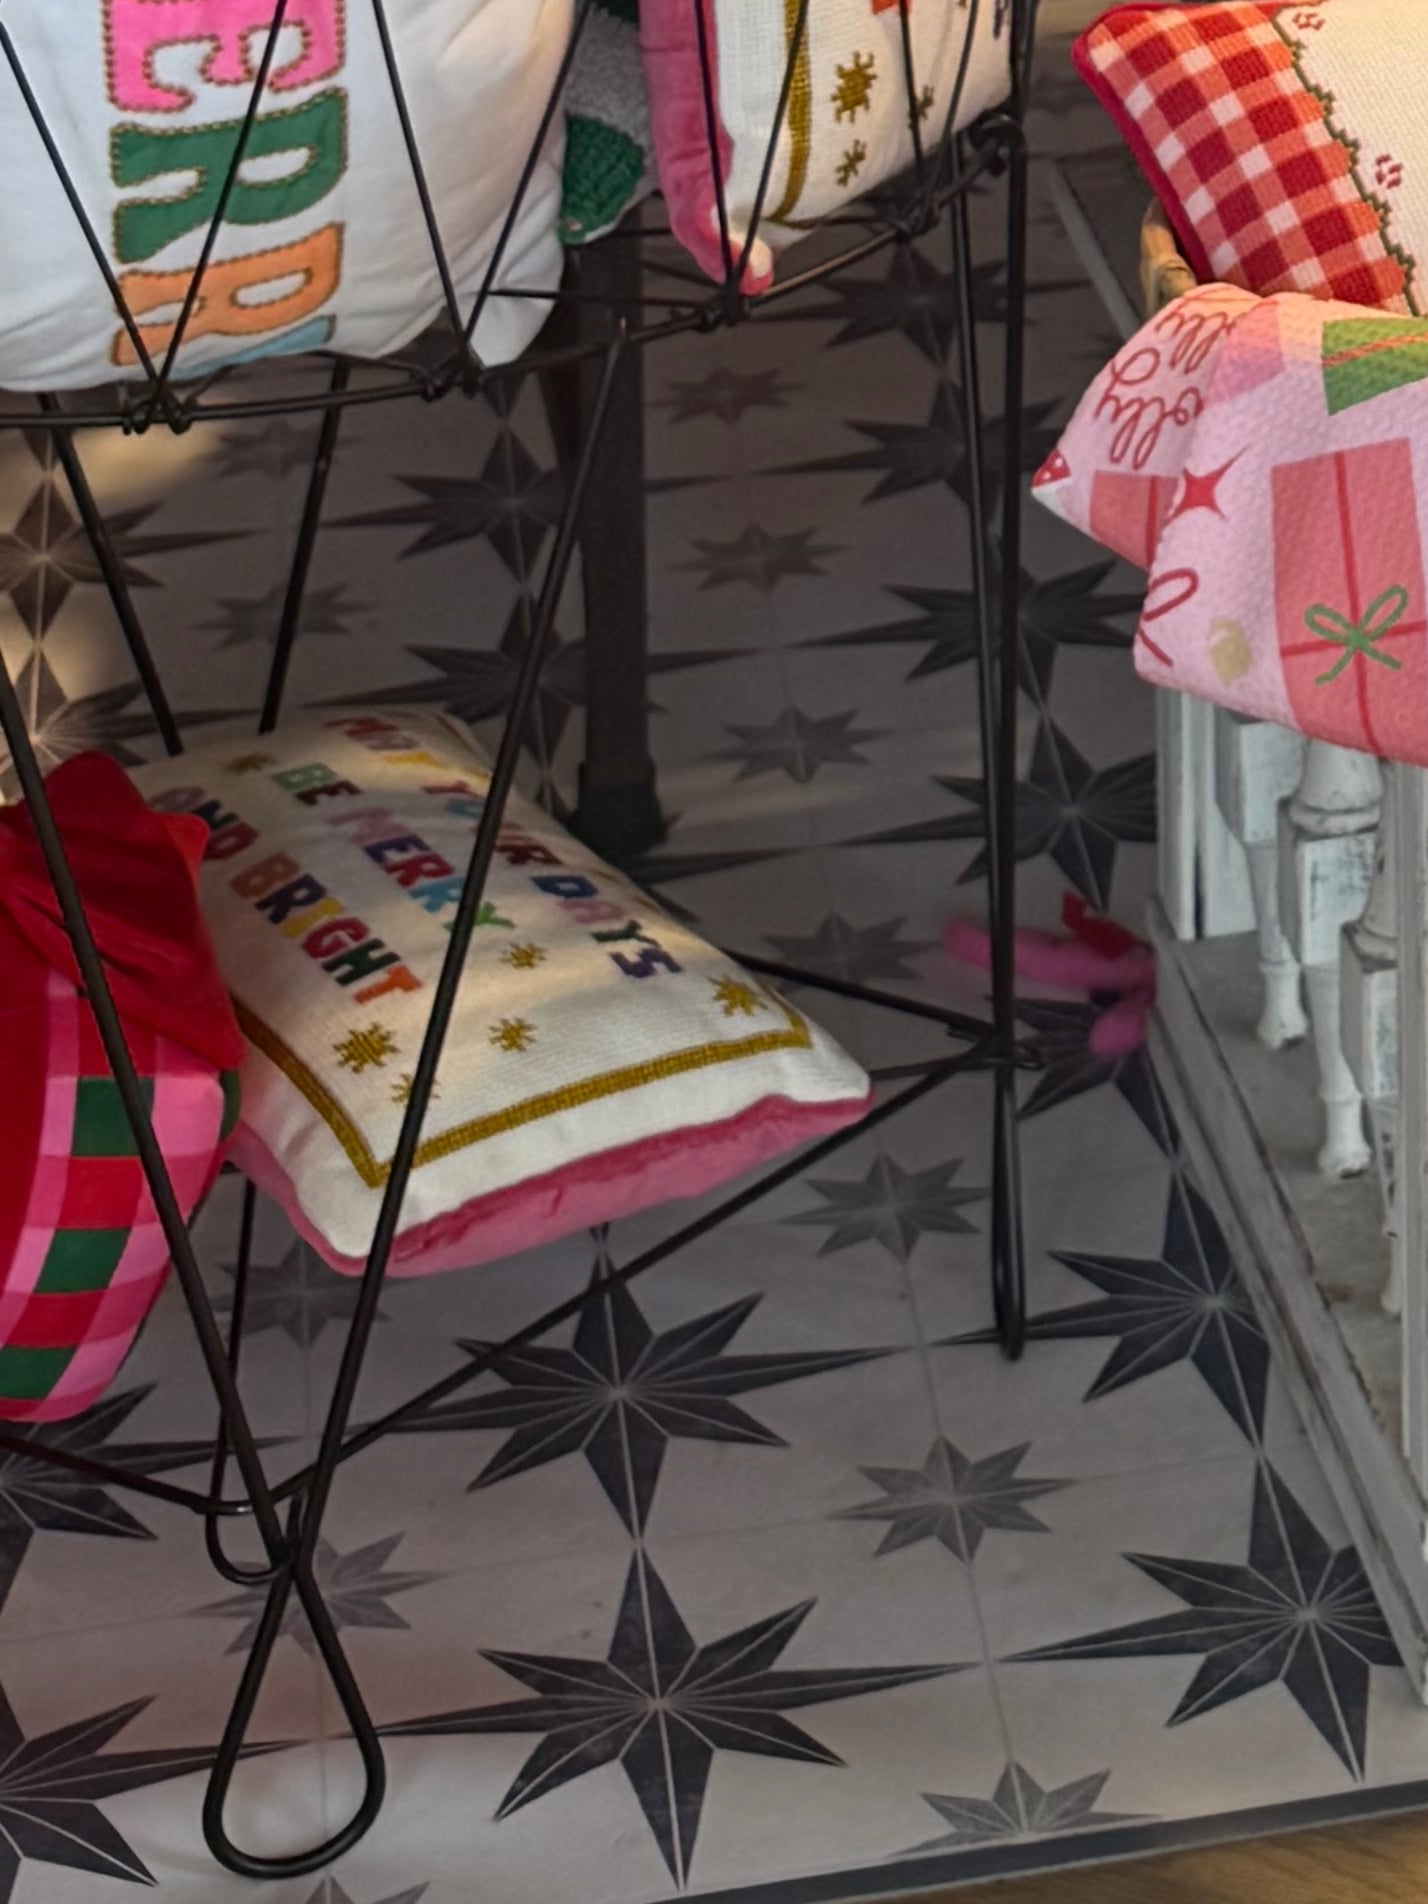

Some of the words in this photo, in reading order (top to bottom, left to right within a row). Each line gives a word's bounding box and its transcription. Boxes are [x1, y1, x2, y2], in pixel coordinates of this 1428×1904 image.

[271, 762, 362, 806] BE
[325, 805, 516, 935] MERRY
[229, 851, 423, 1005] BRIGHT
[530, 873, 684, 979] DAYS
